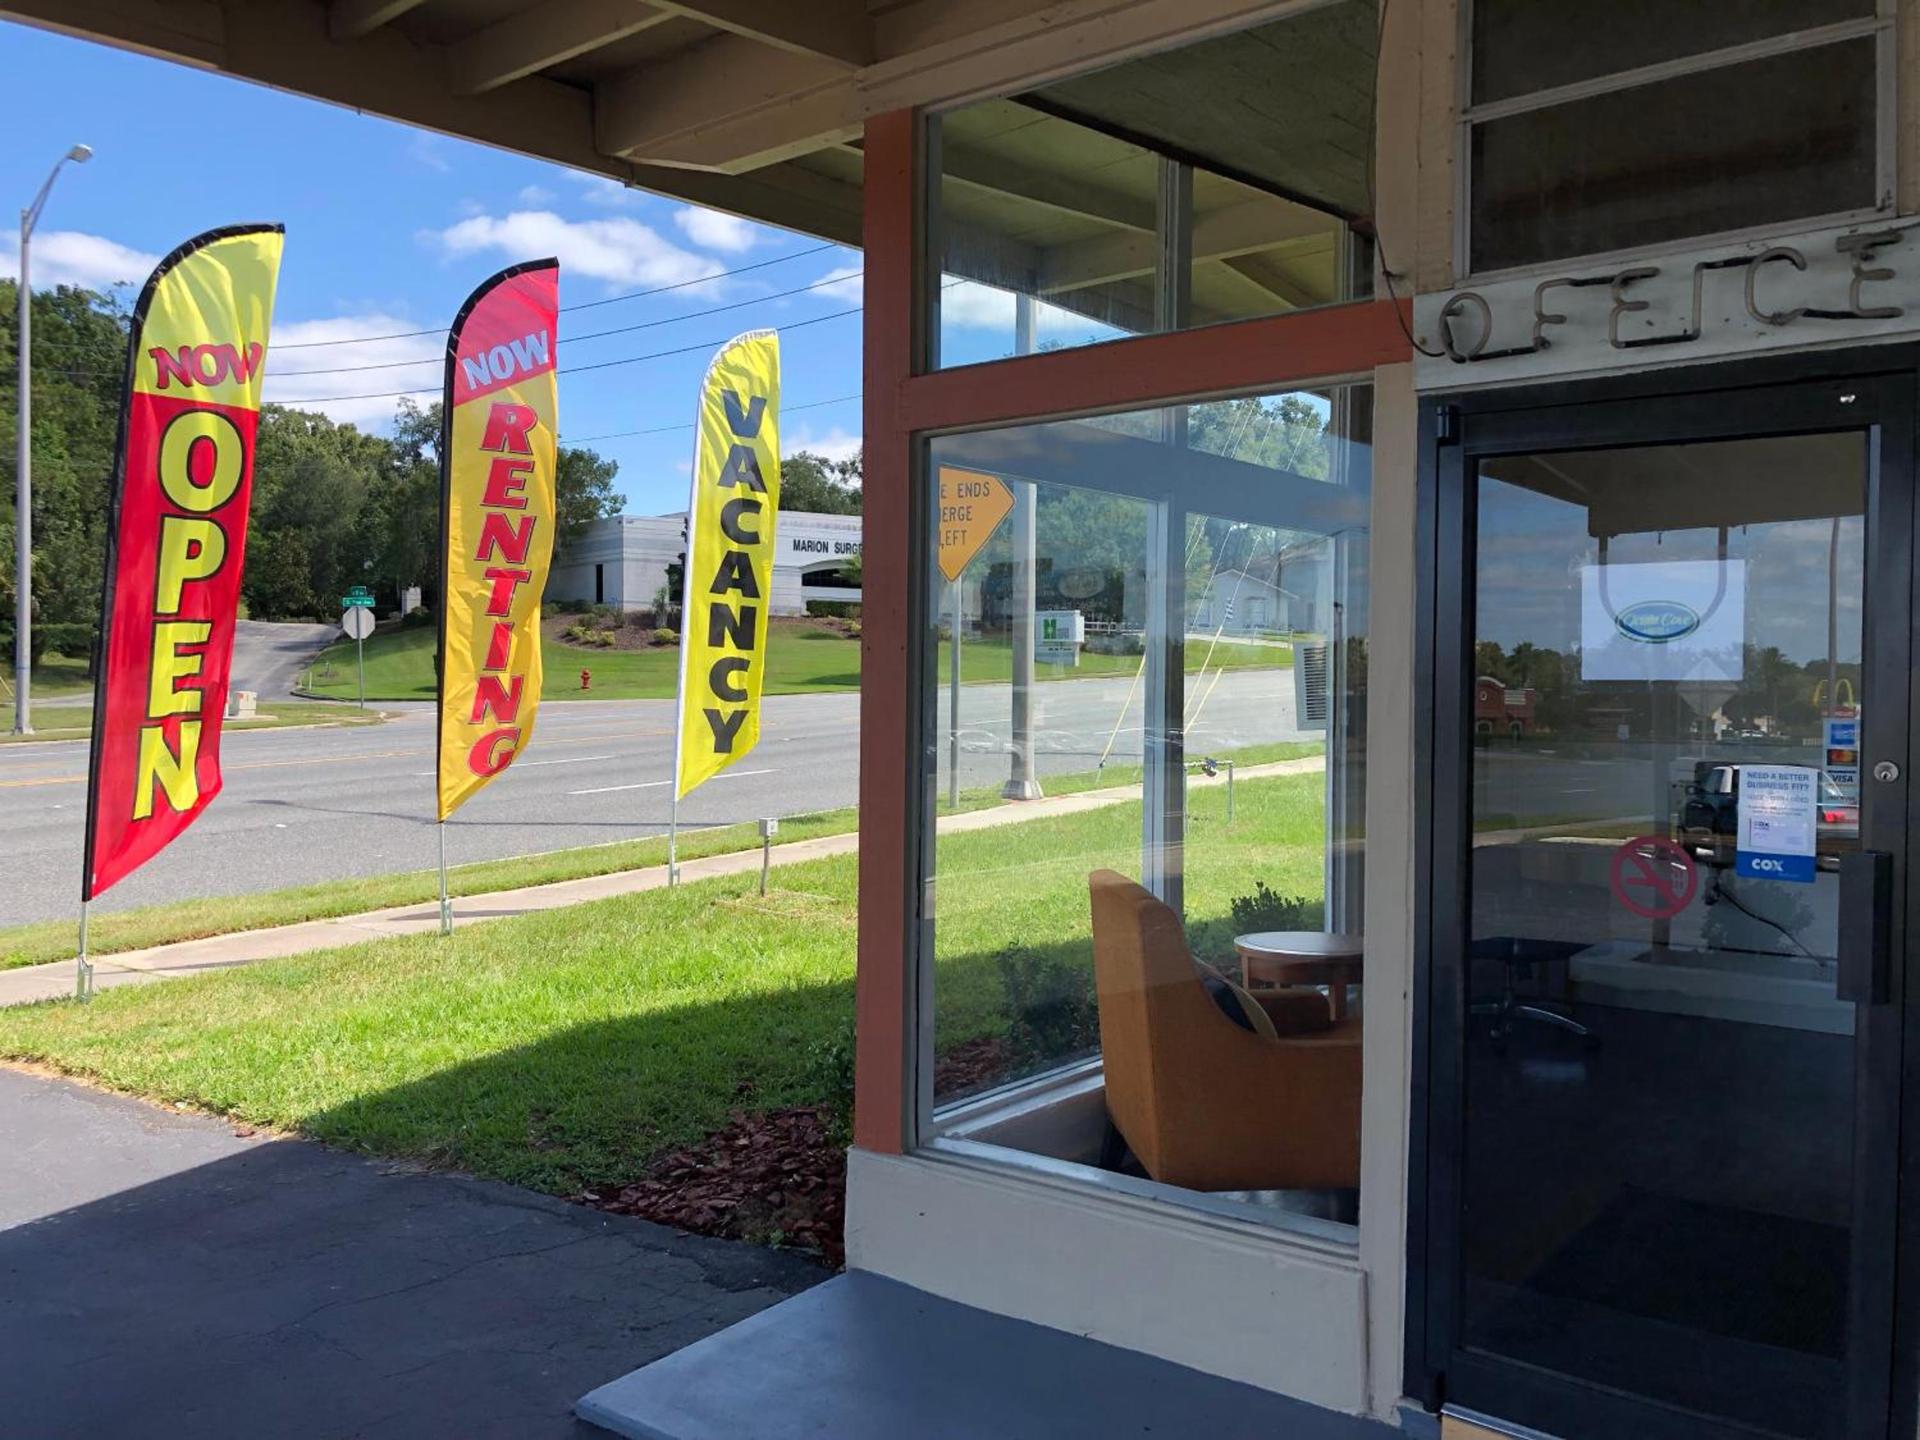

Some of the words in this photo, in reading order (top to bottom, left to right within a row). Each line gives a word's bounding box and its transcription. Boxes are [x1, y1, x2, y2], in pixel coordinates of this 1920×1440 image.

[1438, 230, 1905, 364] OFFICE
[148, 342, 264, 389] NOW
[462, 330, 549, 389] NOW
[957, 481, 990, 498] ENDS
[941, 505, 972, 522] ERGE
[793, 539, 829, 553] MARION
[702, 387, 768, 753] VACANCY
[467, 402, 538, 778] RENTING
[132, 408, 245, 822] OPEN
[1747, 771, 1769, 779] NEED
[1778, 772, 1809, 781] BETTER
[1832, 774, 1853, 783] VISA
[1751, 858, 1784, 872] COX
